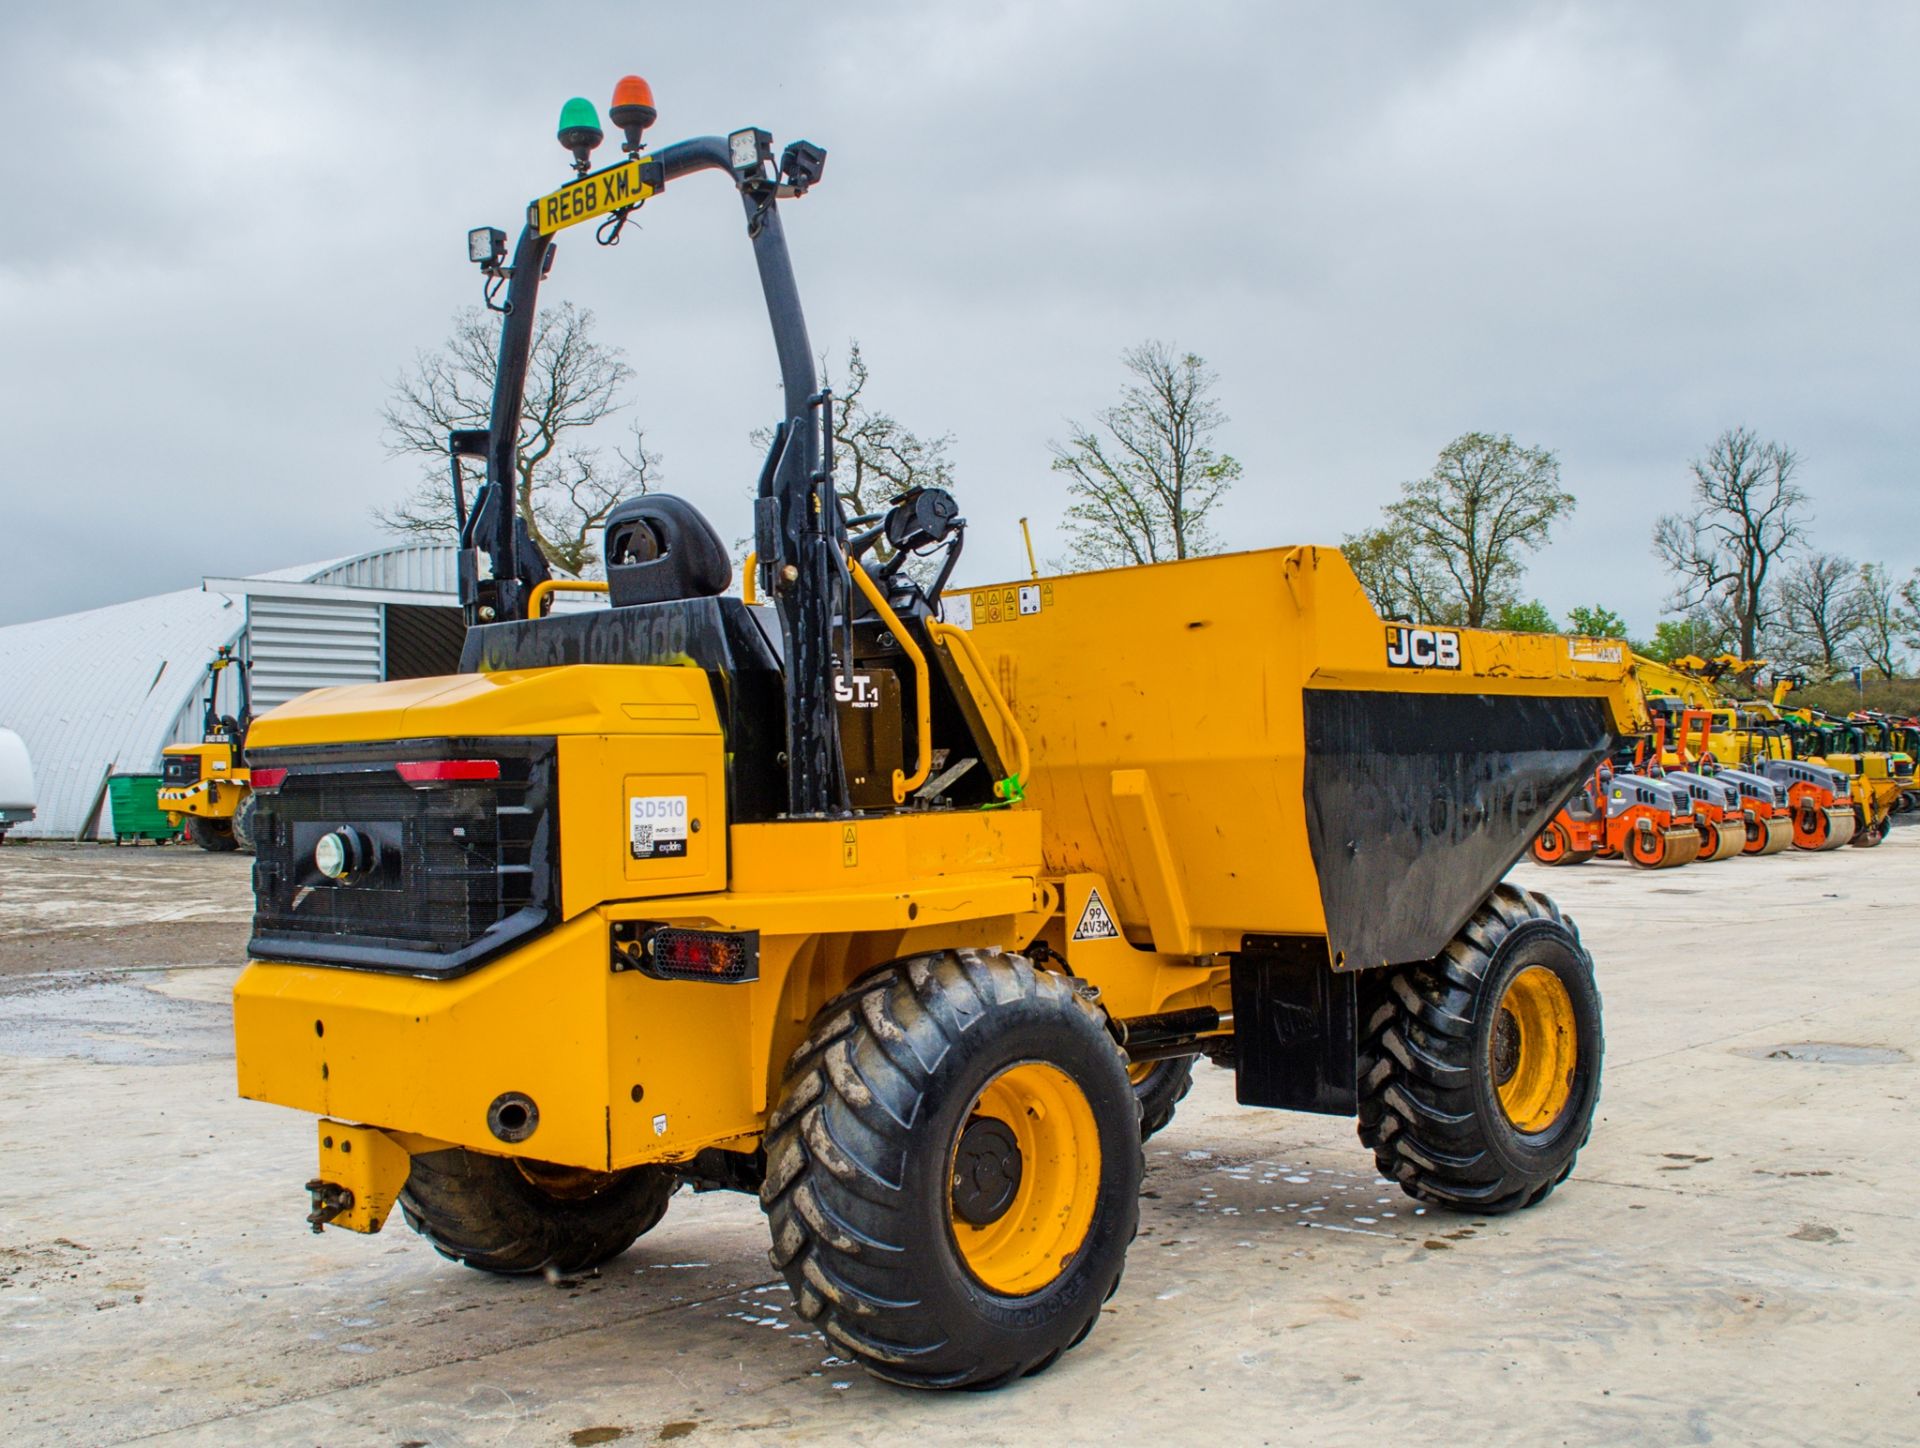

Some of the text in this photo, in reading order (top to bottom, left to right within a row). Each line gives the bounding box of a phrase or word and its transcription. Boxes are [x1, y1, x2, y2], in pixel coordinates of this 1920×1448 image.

[546, 169, 642, 226] RE68 XMJ
[1388, 628, 1460, 667] JCB
[634, 800, 685, 818] SD510
[1089, 908, 1102, 920] 99
[1082, 920, 1110, 934] AV3M
